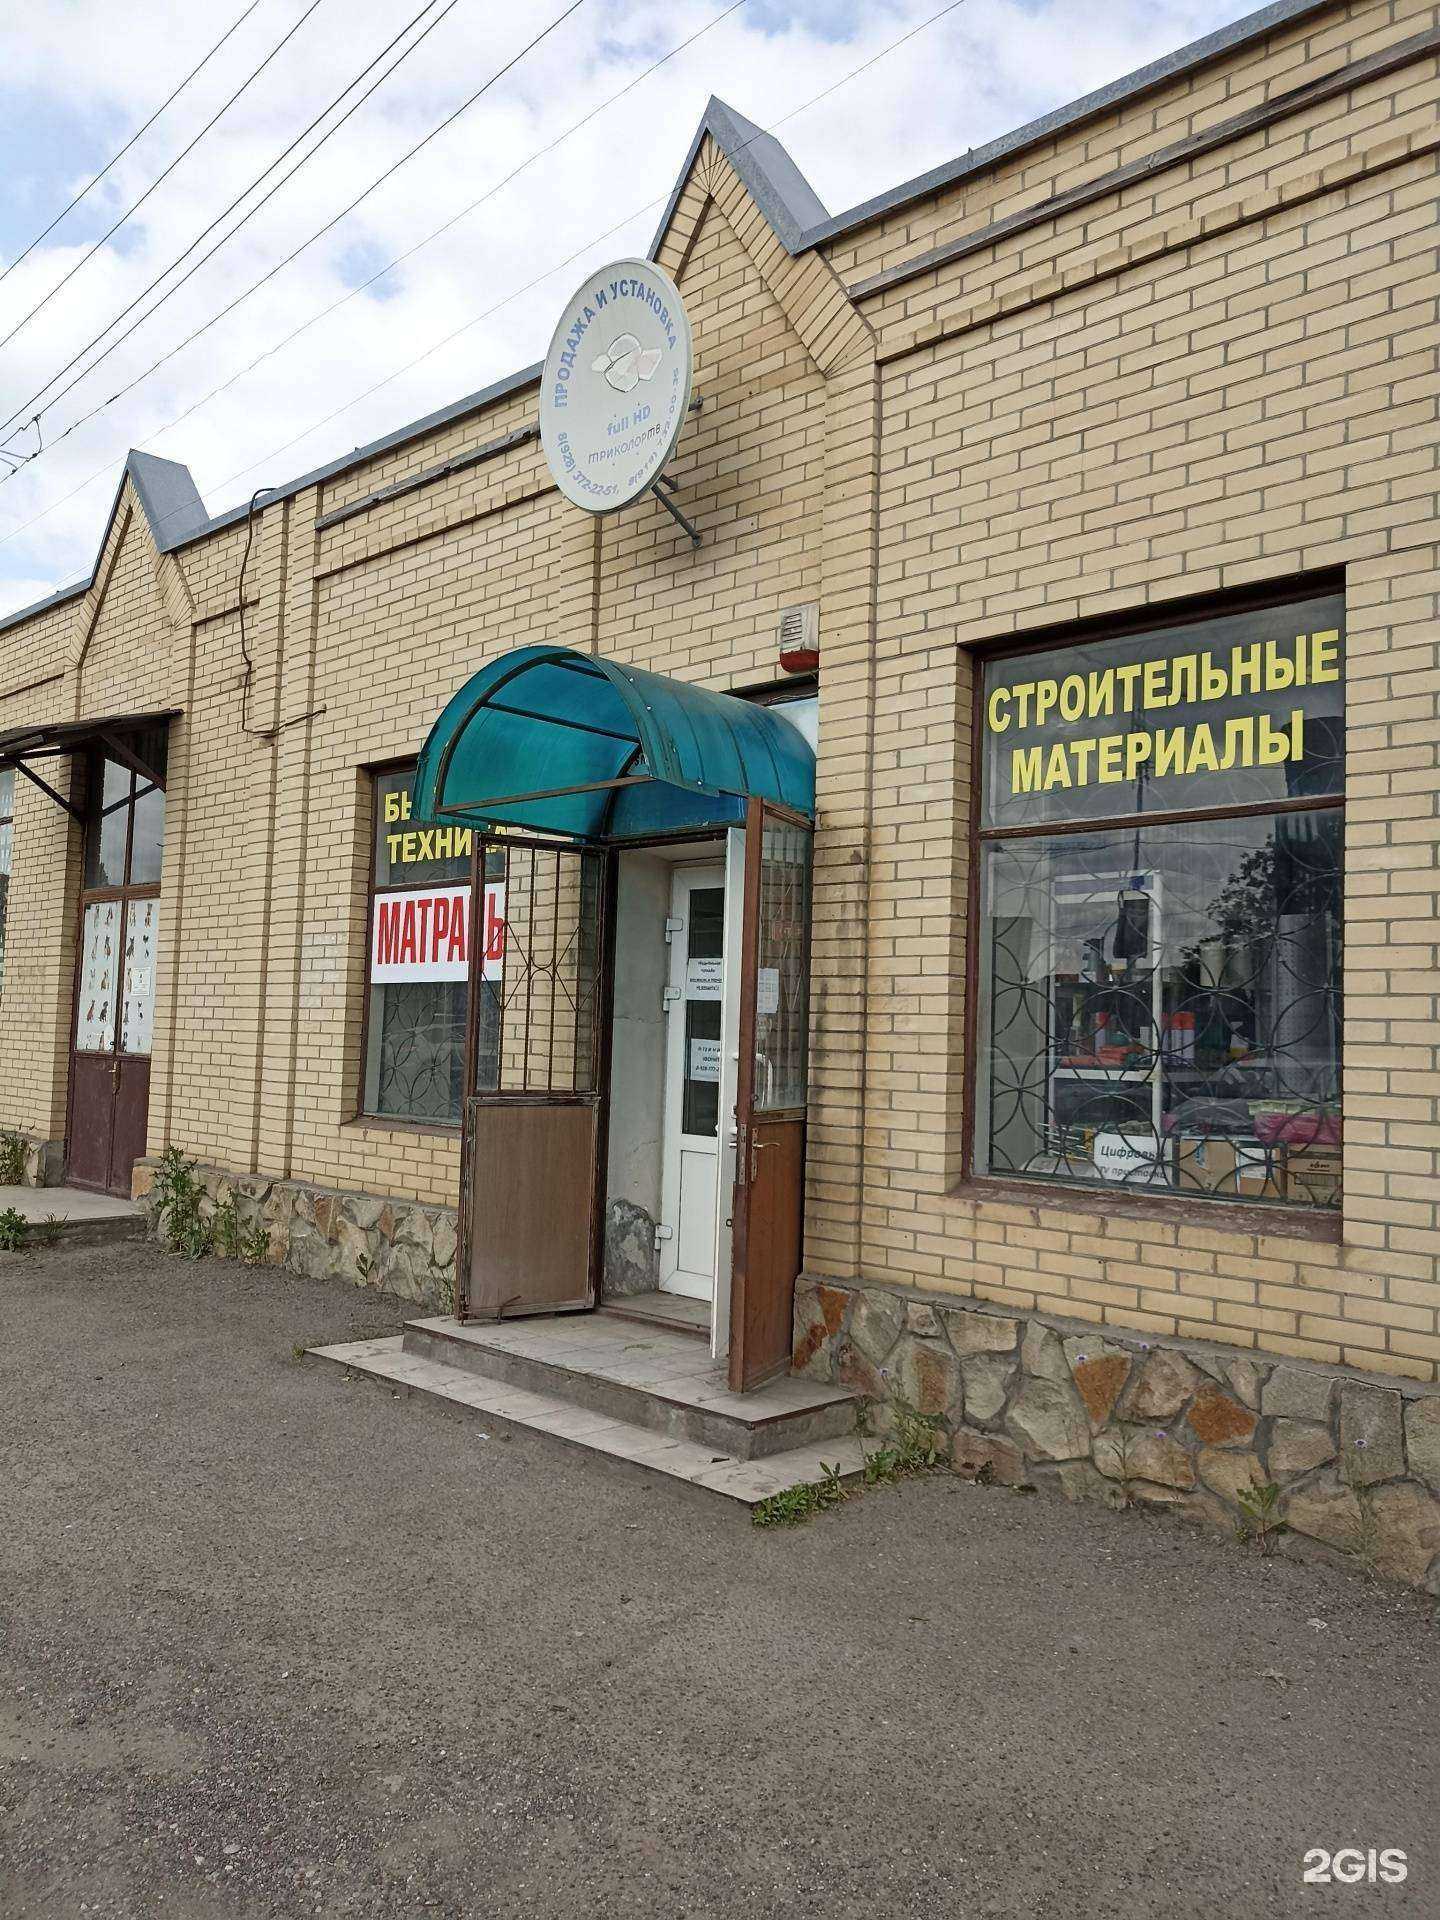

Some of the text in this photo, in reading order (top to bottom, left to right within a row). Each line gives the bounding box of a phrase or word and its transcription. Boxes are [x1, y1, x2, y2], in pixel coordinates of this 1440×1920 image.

[555, 279, 677, 407] ПРОДАЖА И УСТАНОВКА
[606, 404, 651, 436] full HD
[988, 629, 1340, 733] СТРОИТЕЛЬНЫЕ
[1011, 709, 1304, 795] МАТЕРИАЛЫ
